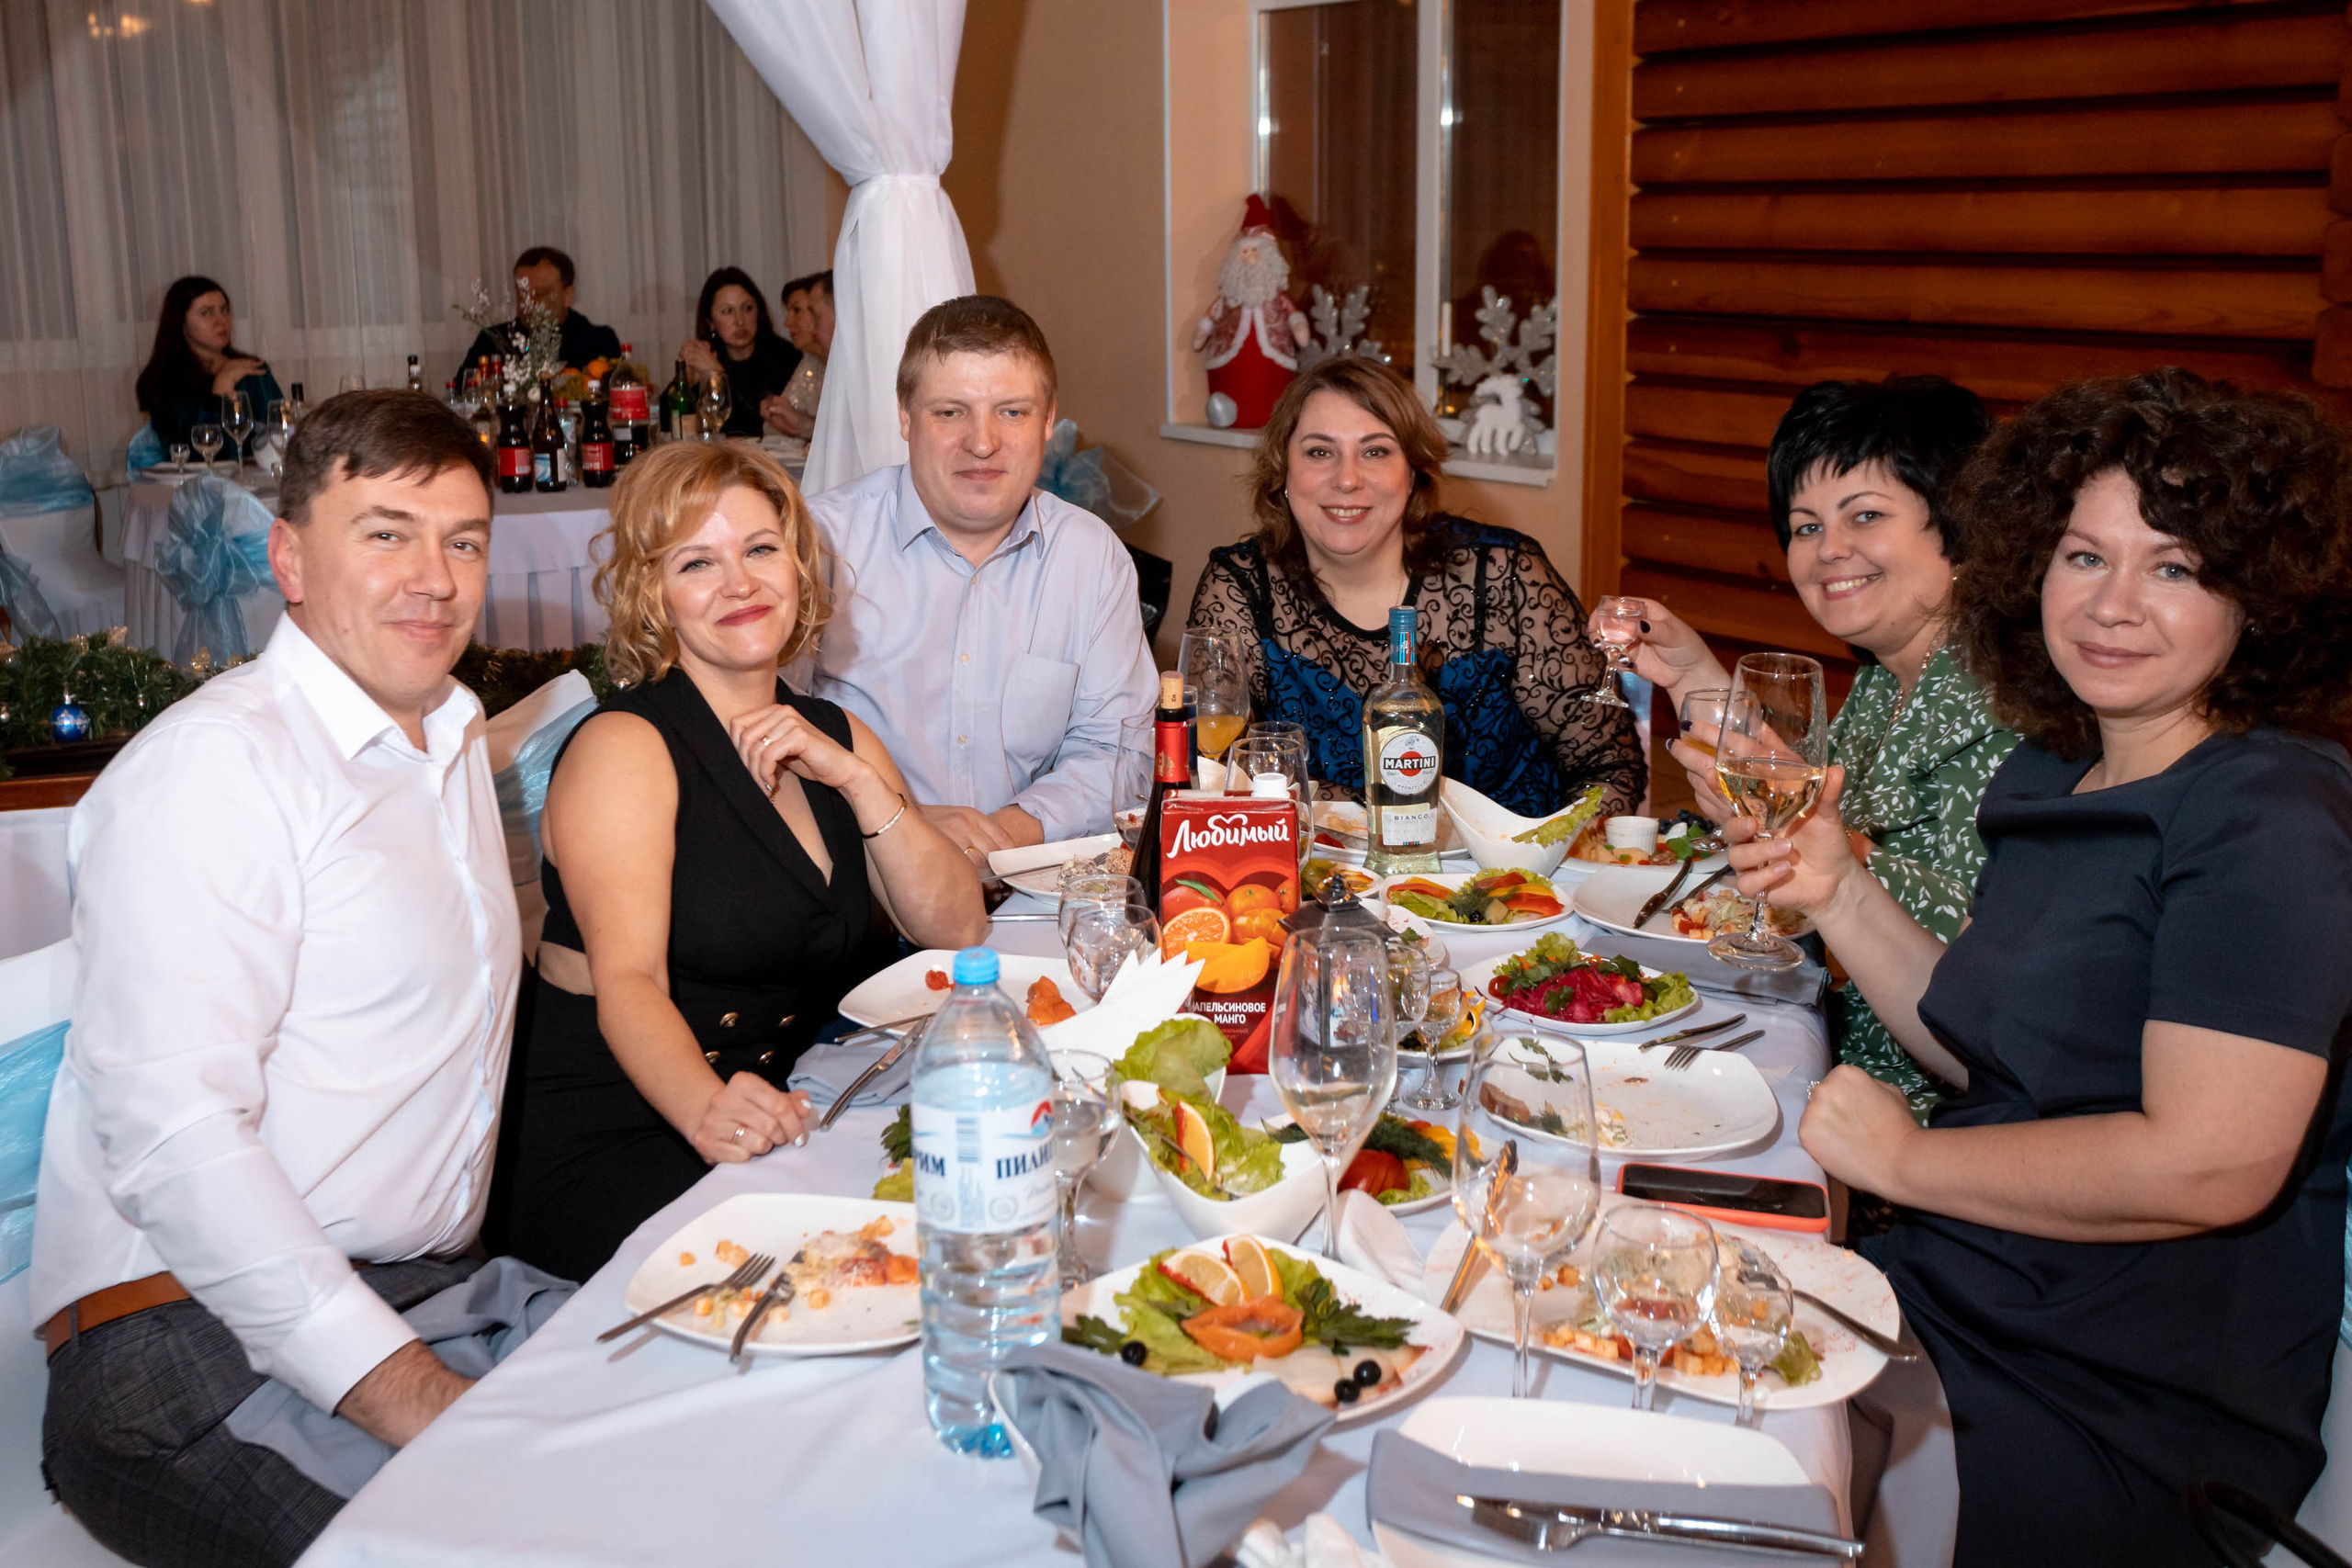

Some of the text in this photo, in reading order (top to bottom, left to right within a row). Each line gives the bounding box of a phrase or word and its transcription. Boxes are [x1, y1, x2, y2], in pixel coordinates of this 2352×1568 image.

[1385, 757, 1434, 769] MARTINI
[1166, 814, 1290, 859] Любимый
[1215, 1014, 1246, 1024] МАНГО
